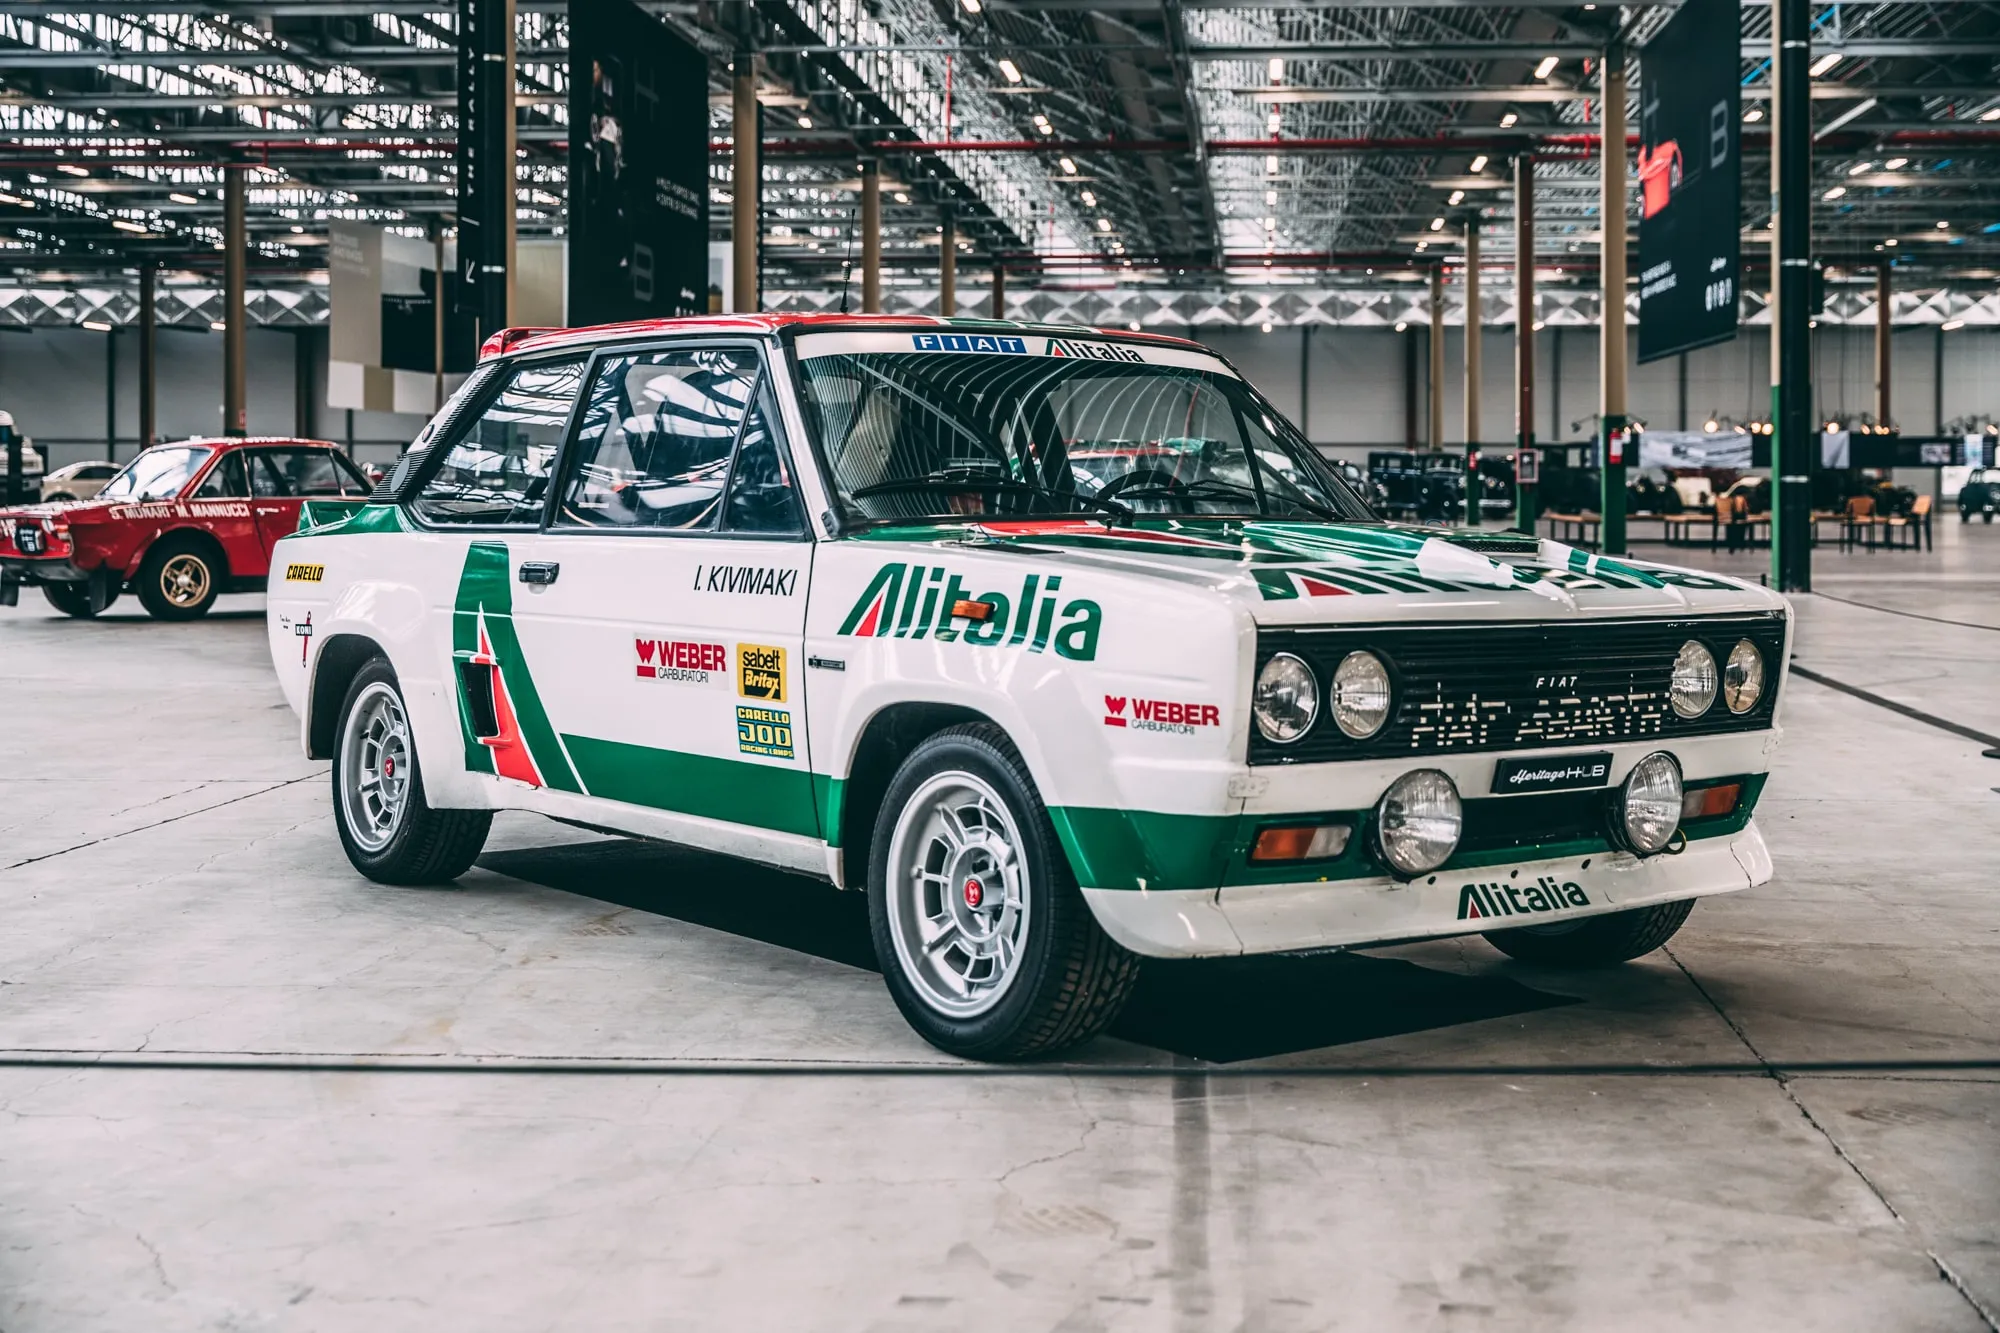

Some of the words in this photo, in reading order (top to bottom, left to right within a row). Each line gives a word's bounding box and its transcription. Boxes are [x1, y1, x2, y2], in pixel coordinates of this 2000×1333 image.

[917, 335, 1022, 352] FIAT
[1046, 338, 1145, 363] Alitalia
[125, 505, 170, 520] MUNARI
[192, 503, 250, 518] MANNUCCI
[286, 565, 325, 582] CARELLO
[707, 565, 799, 597] KIVIMAKI
[837, 562, 1103, 662] Alitalia
[296, 625, 312, 635] KONI
[657, 640, 727, 672] WEBER
[743, 648, 781, 671] sabelt
[658, 666, 709, 684] CARBURATORI
[744, 669, 781, 692] Britax
[1536, 675, 1578, 689] FIAT
[737, 707, 790, 725] CARELLO
[1131, 698, 1220, 727] WEBER
[1131, 718, 1196, 736] CARBURATORI
[1509, 768, 1566, 785] Heritage
[1566, 764, 1606, 780] HUB
[1457, 876, 1591, 920] Alitalia
